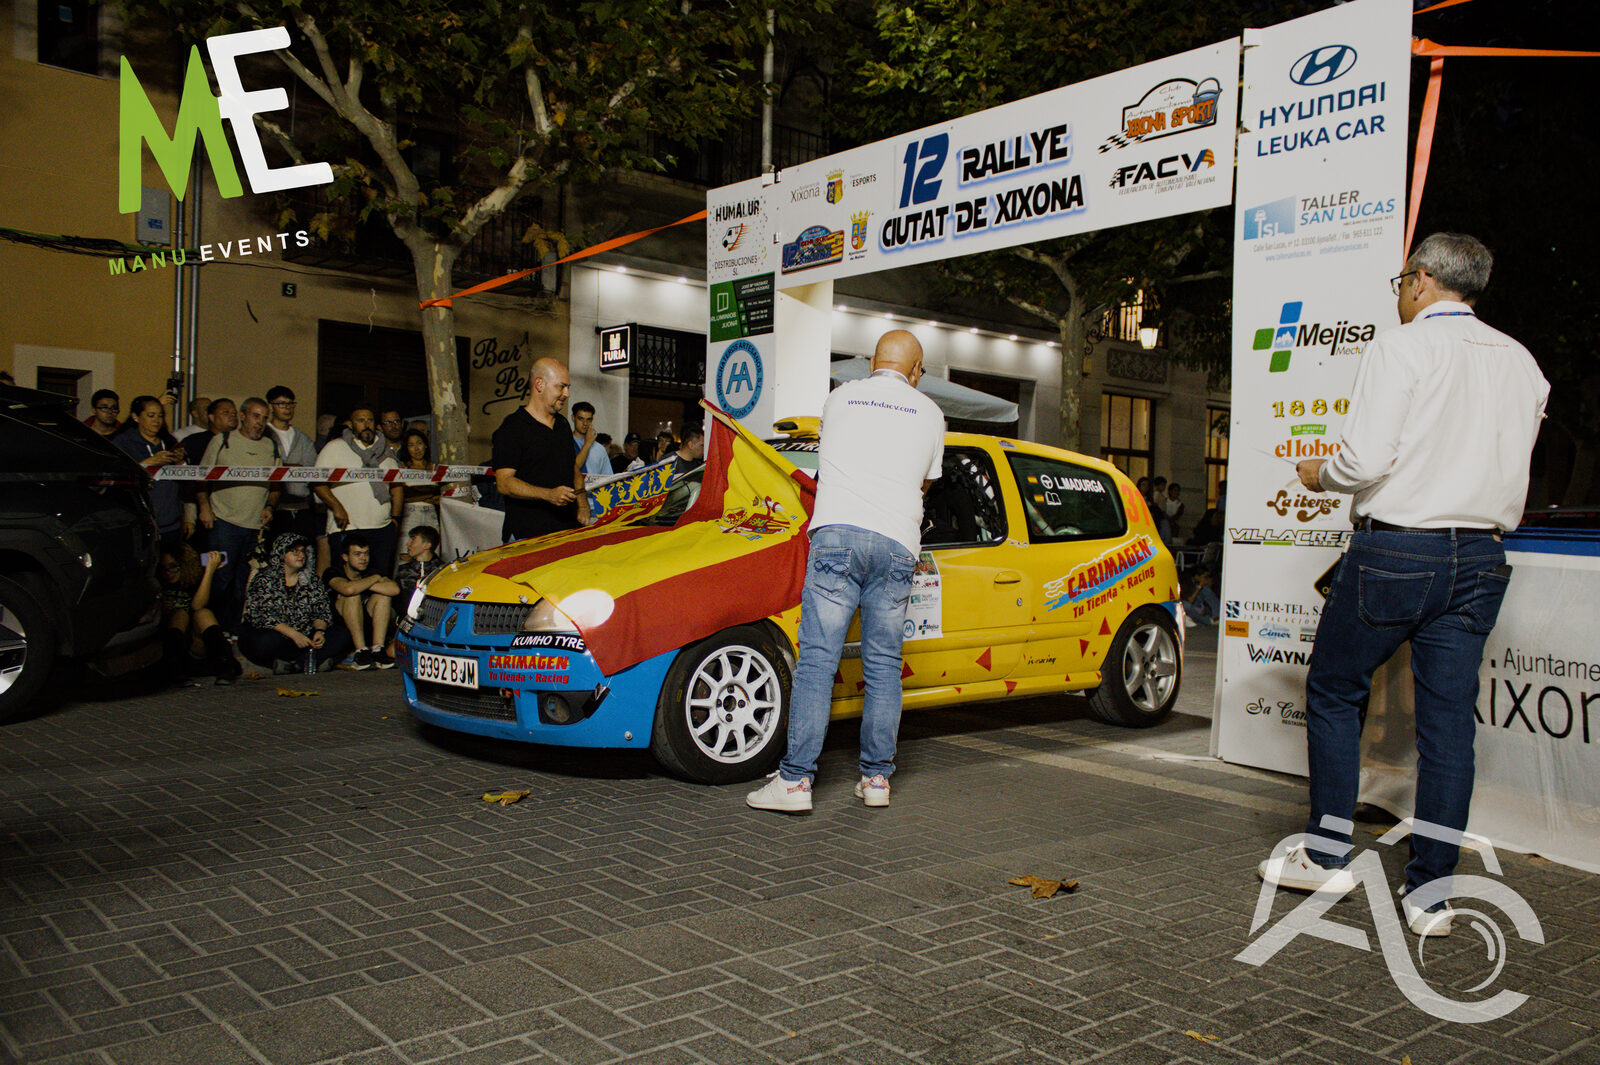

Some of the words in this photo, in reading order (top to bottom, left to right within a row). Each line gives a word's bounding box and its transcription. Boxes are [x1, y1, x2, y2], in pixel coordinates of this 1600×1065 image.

[1258, 81, 1386, 129] HYUNDAI
[1126, 112, 1166, 138] XIXONA
[1171, 99, 1214, 128] SPORT
[1257, 127, 1330, 157] LEUKA
[1335, 114, 1385, 141] CAR
[899, 132, 949, 210] 12
[962, 123, 1069, 183] RALLYE
[851, 173, 877, 187] ESPORTS
[790, 184, 820, 203] Xixona
[1301, 190, 1360, 211] TALLER
[715, 200, 760, 222] HUMALUR
[882, 204, 950, 248] CIUTAT
[956, 195, 988, 233] DE
[995, 174, 1084, 224] XIXONA
[1300, 208, 1334, 226] SAN
[1340, 198, 1396, 220] LUCAS
[714, 254, 758, 270] DISTRIBUCIONES
[284, 283, 295, 296] 5
[1296, 320, 1376, 356] Mejisa
[472, 337, 522, 369] Bar
[603, 348, 627, 362] TURIA
[847, 399, 918, 415] www.fedacv.com
[1271, 398, 1350, 418] 1880
[1275, 439, 1292, 458] el
[1295, 438, 1341, 458] lobo
[160, 466, 197, 477] Xixona
[226, 466, 260, 478] Xixona
[288, 467, 320, 479] Xixona
[346, 470, 376, 480] Xixona
[398, 471, 425, 480] Xixona
[1053, 476, 1106, 494] L.MADURGA
[1266, 489, 1291, 517] La
[1293, 494, 1341, 523] itense
[1067, 538, 1153, 600] CARIMAGEN
[1073, 604, 1085, 619] Tu
[1086, 588, 1118, 613] Tienda
[1127, 565, 1156, 591] Racing
[513, 635, 553, 647] KUMHO
[554, 635, 585, 650] TYRE
[1258, 627, 1291, 639] Cimer
[419, 655, 447, 681] 9392
[451, 659, 475, 686] BJM
[488, 655, 570, 670] CARIMAGEN
[489, 672, 498, 681] Tu
[498, 672, 526, 682] Tienda
[535, 673, 569, 685] Racing
[1246, 697, 1272, 715] Sa
[1474, 658, 1600, 744] ixon
